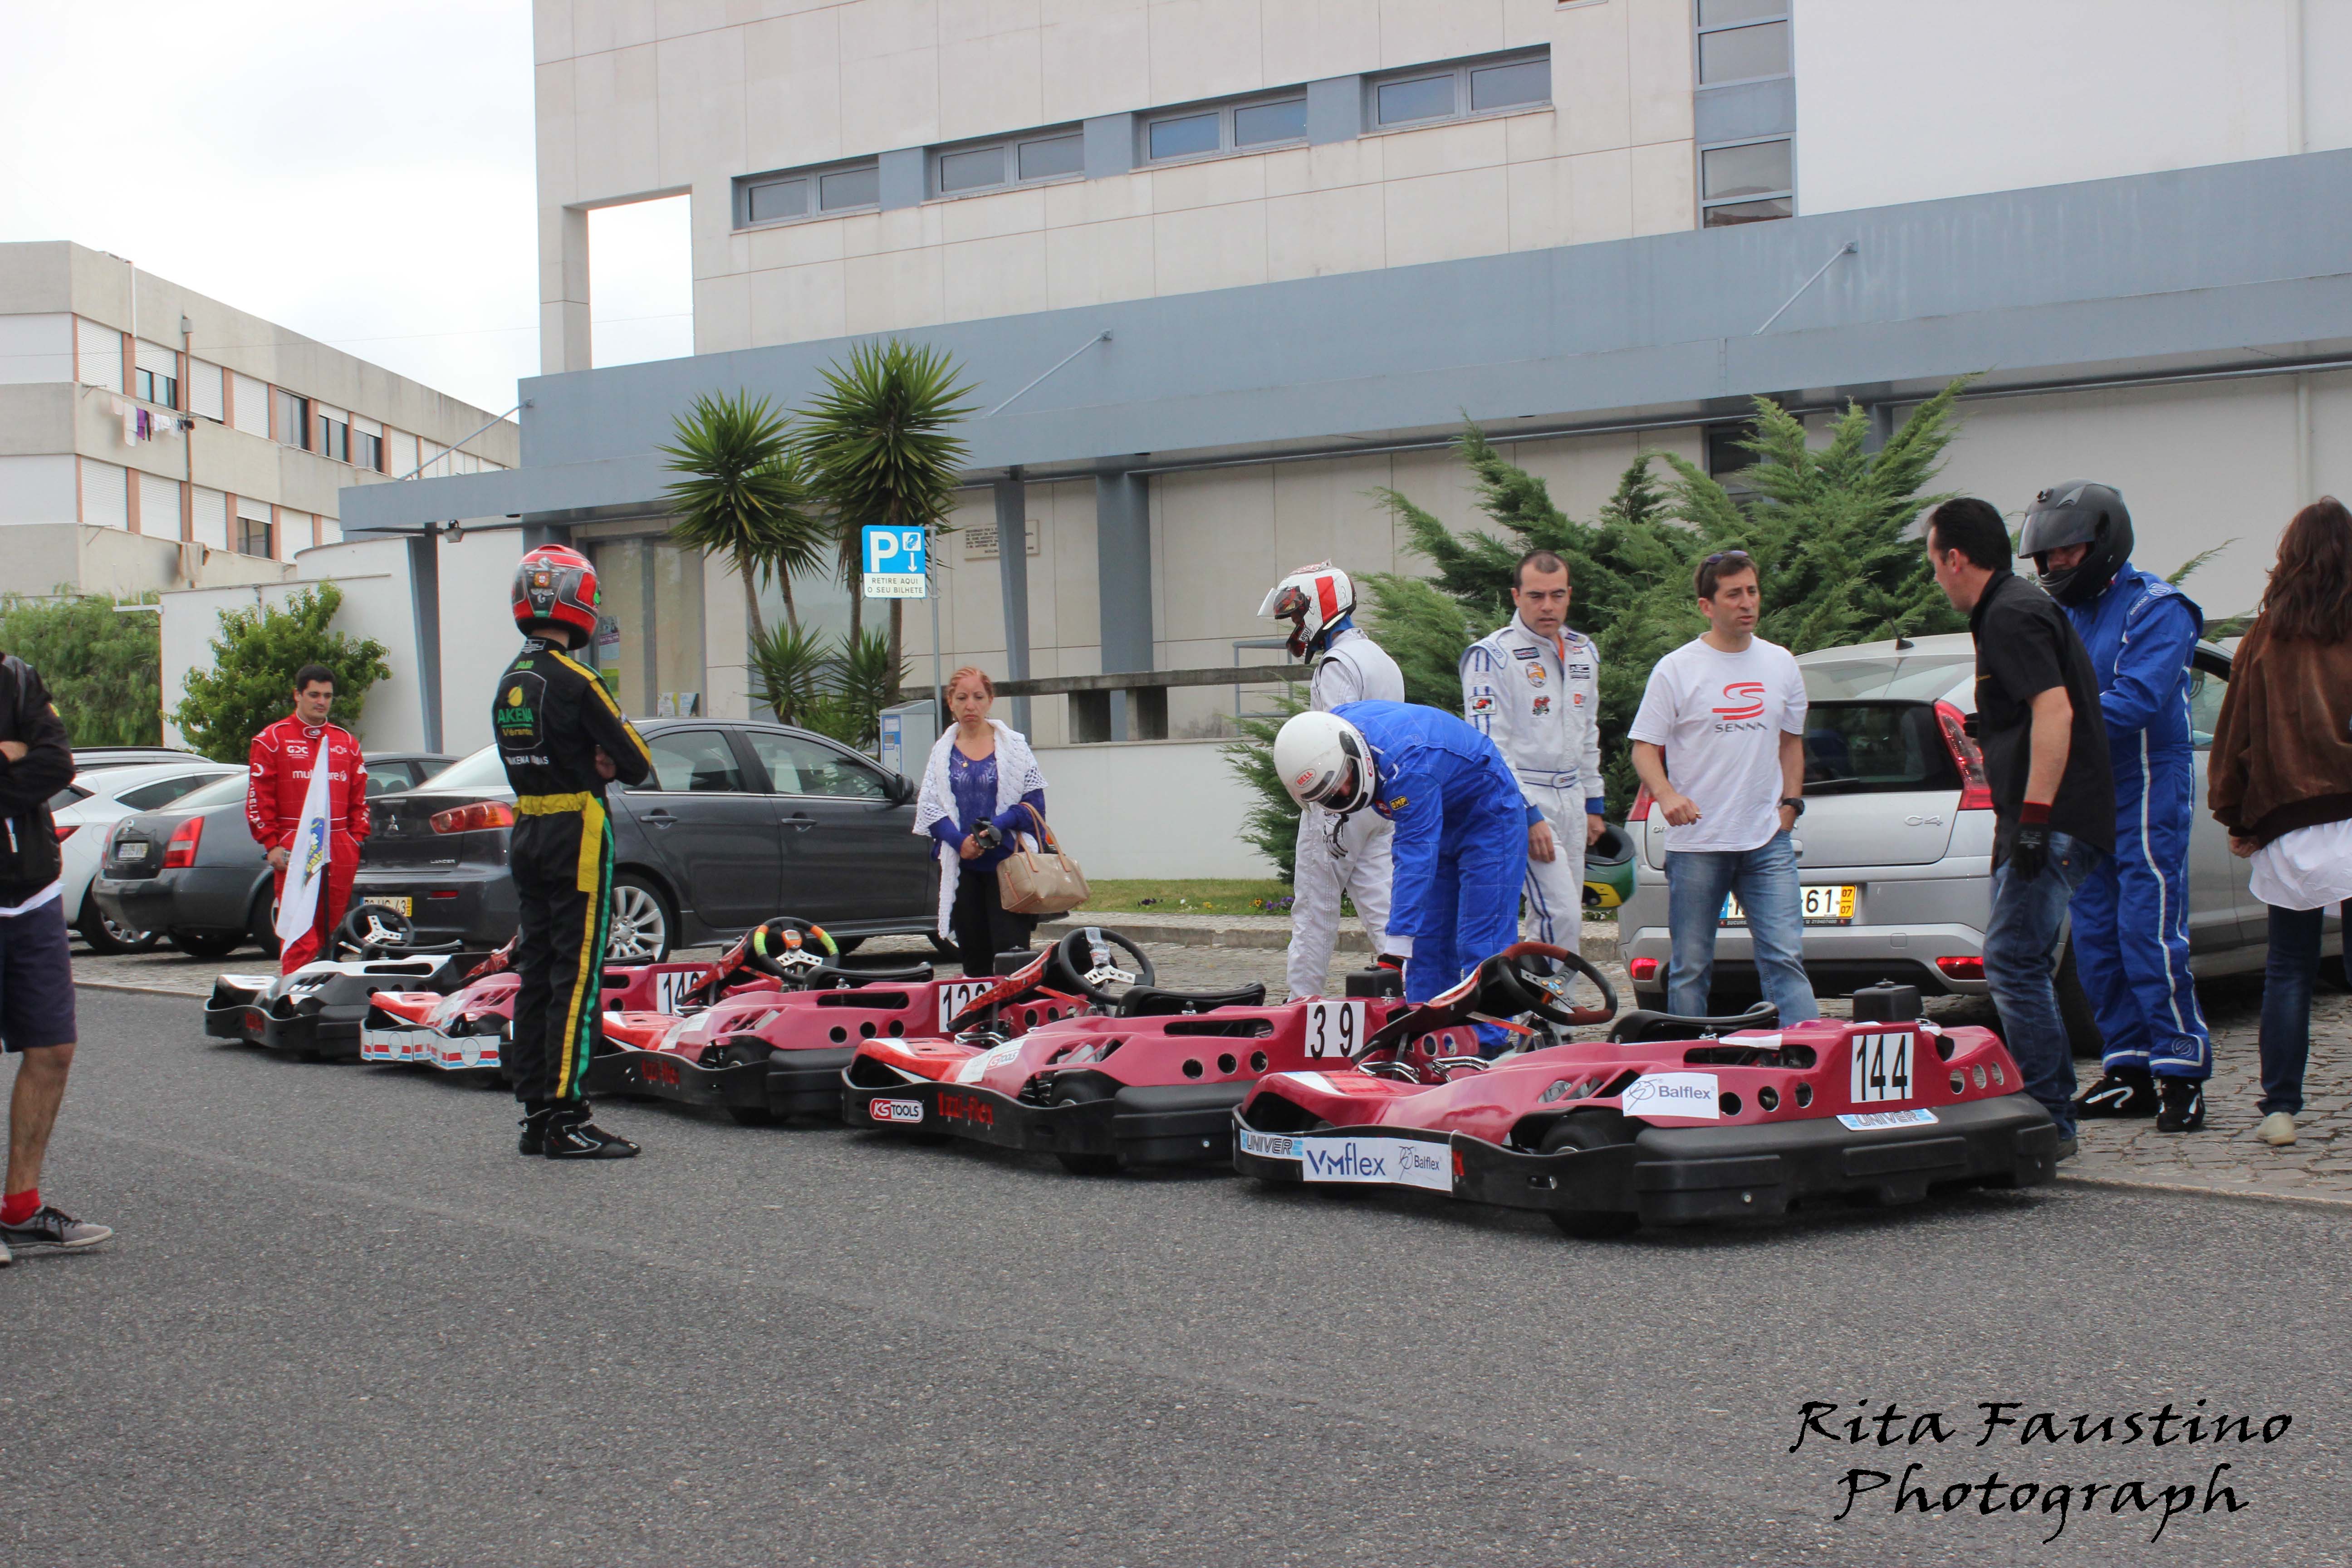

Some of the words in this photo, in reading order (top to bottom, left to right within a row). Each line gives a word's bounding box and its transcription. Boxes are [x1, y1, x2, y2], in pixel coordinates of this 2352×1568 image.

[870, 531, 899, 573] P
[497, 707, 534, 724] AKENA
[1714, 722, 1767, 733] SENNA
[1296, 771, 1313, 785] BELL
[1391, 797, 1407, 809] OMP
[1905, 815, 1942, 826] C4
[1842, 888, 1852, 897] 07
[1841, 905, 1851, 914] 07
[1856, 1034, 1907, 1101] 144
[1658, 1085, 1711, 1100] Balflex
[873, 1102, 891, 1117] KS
[891, 1104, 919, 1117] TOOLS
[1857, 1110, 1917, 1127] UNIVER
[1246, 1137, 1293, 1156] UNIVER
[1414, 1155, 1440, 1171] Balflex
